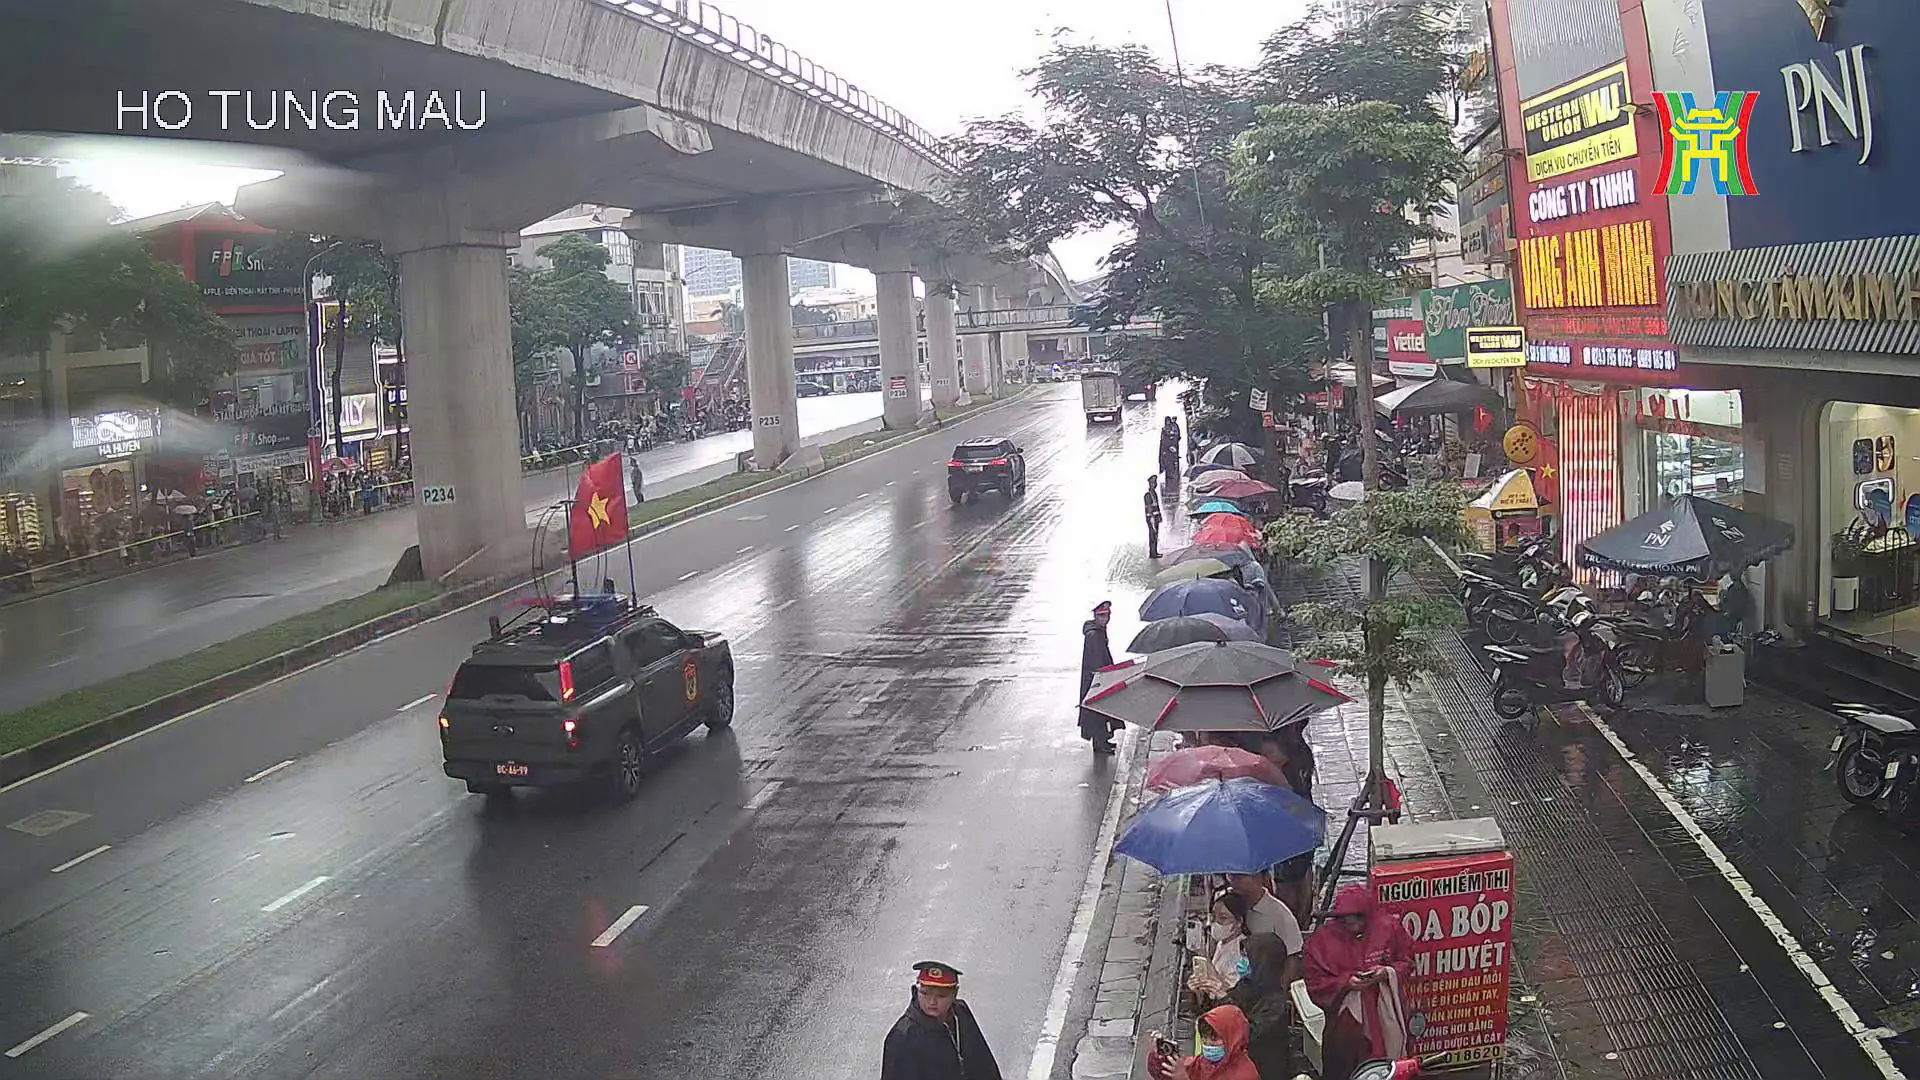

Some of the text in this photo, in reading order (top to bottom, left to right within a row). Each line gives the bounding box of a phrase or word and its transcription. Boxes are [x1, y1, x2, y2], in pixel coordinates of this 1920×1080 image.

[1525, 82, 1621, 131] WESTERN WU
[1780, 44, 1872, 165] PNJ
[1542, 115, 1582, 142] UNION
[1529, 169, 1636, 222] CÔNG TY TNHH
[1520, 228, 1564, 308] VÀNG
[1565, 228, 1602, 307] ANH
[760, 416, 780, 426] P235
[424, 487, 455, 503] P234
[1644, 532, 1672, 548] PNJ
[1378, 868, 1510, 904] NGƯỜI KHIẾM THỊ
[1401, 893, 1509, 942] OA BÓP
[1436, 939, 1506, 974] HUYỆT
